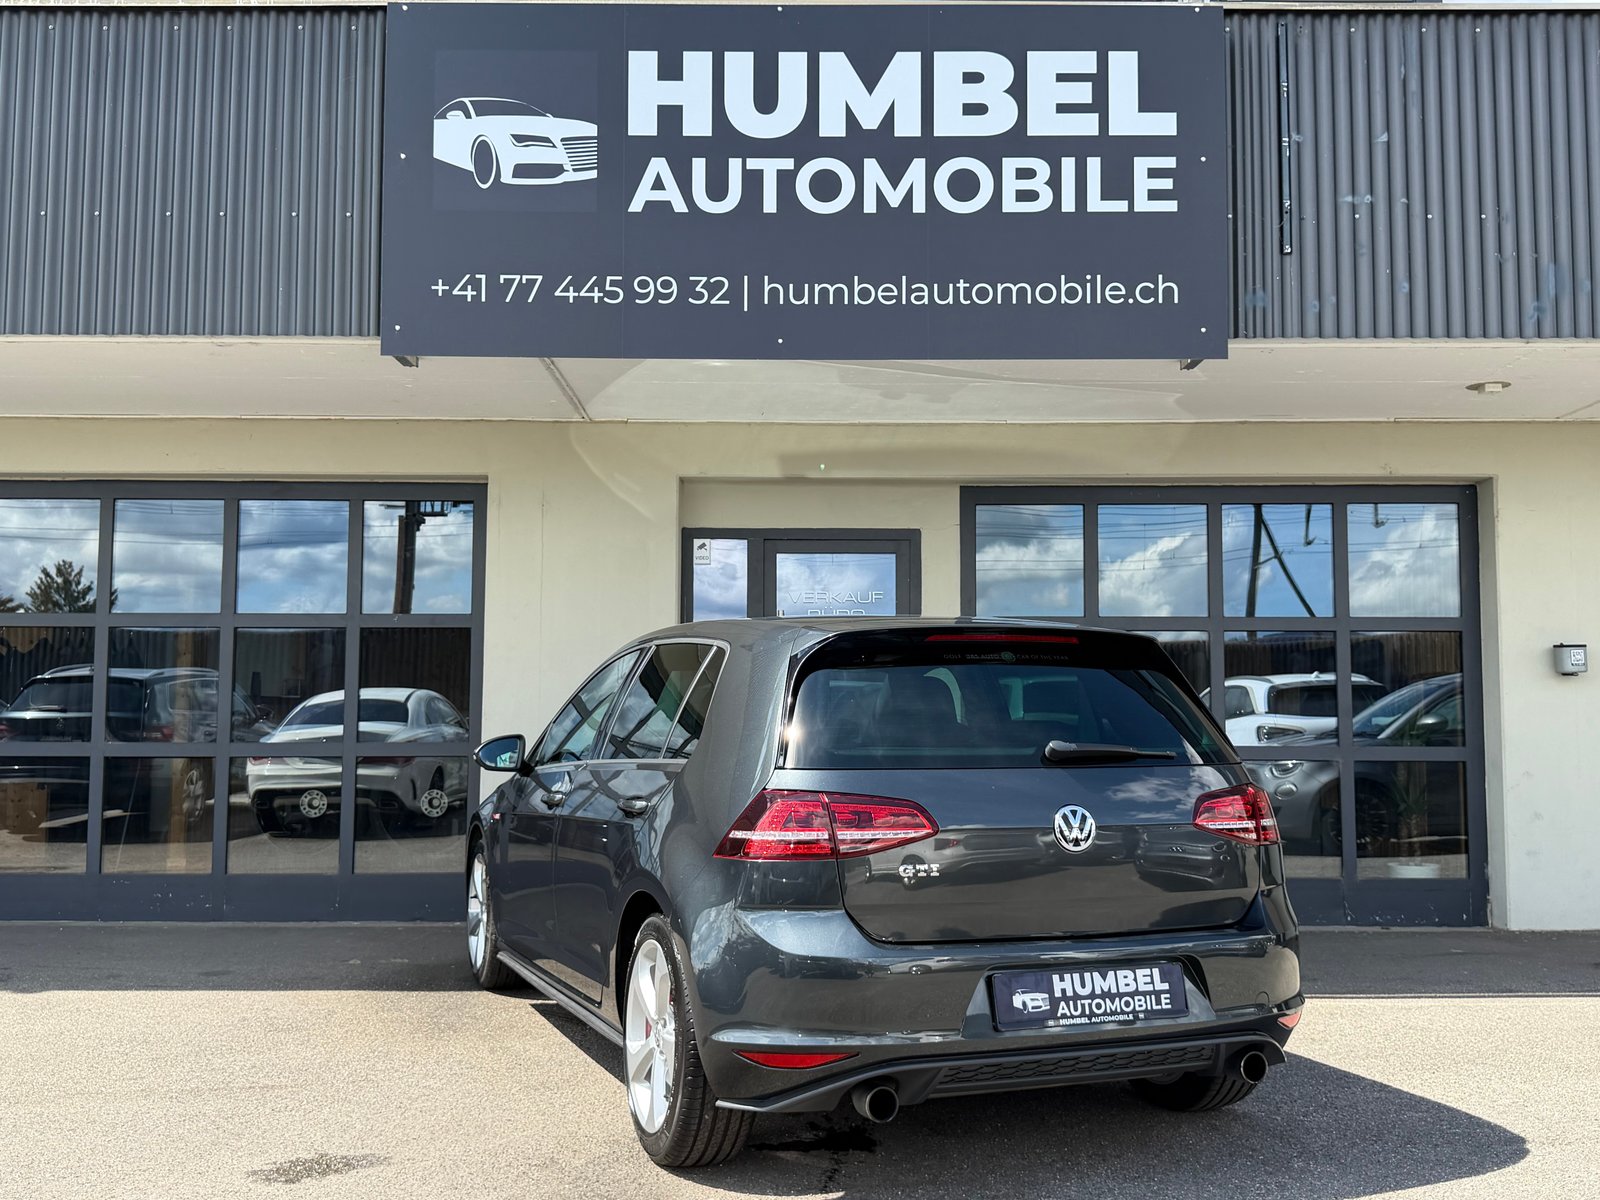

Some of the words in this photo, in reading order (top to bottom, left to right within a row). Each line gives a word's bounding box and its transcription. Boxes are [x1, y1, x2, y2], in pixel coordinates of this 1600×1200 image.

[628, 51, 1178, 138] HUMBEL
[628, 156, 1178, 214] AUTOMOBILE
[431, 273, 487, 303] +41
[499, 274, 544, 303] 77
[553, 275, 624, 304] 445
[633, 275, 678, 305] 99
[688, 276, 730, 305] 32
[763, 273, 1179, 305] humbelautomobile.ch
[787, 591, 884, 604] VERKAUF
[898, 863, 940, 878] GTI
[1052, 967, 1170, 998] HUMBEL
[1056, 993, 1172, 1017] AUTOMOBILE
[1059, 1017, 1090, 1026] HUMBEL
[1091, 1013, 1134, 1023] AUTOMOBILE
